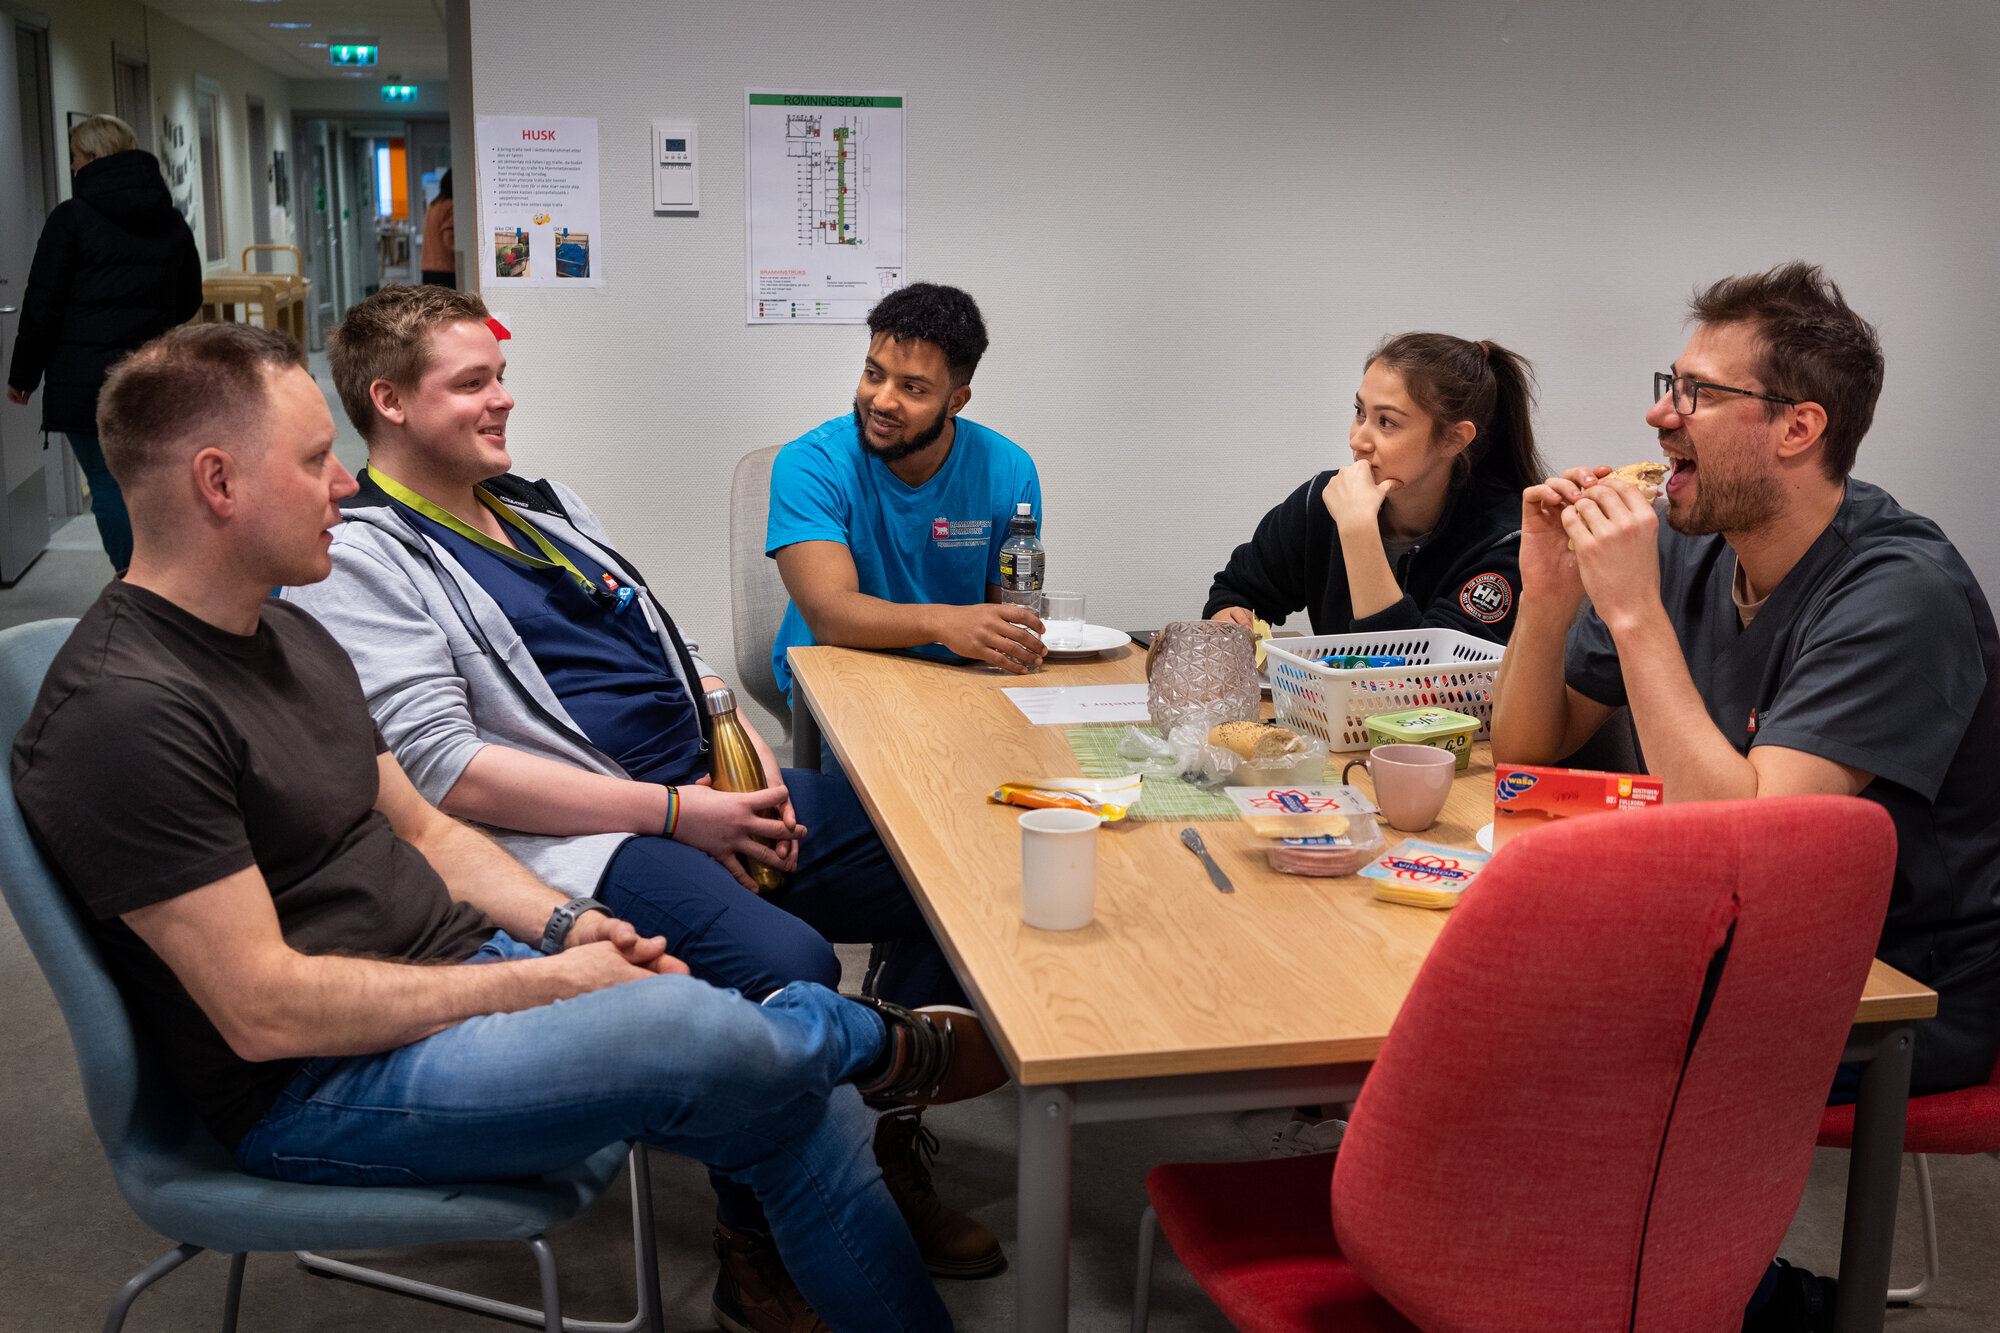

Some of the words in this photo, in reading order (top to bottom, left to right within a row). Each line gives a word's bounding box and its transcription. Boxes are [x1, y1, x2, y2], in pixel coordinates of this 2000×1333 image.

[784, 95, 874, 107] RØMNINGSPLAN
[522, 129, 556, 141] HUSK
[949, 527, 983, 535] KOMMUNE
[1475, 575, 1497, 584] EXTREME
[1473, 584, 1503, 607] HH
[1465, 603, 1482, 618] HANSEN
[1508, 776, 1534, 786] wasa
[1397, 862, 1458, 878] NORVEGIA
